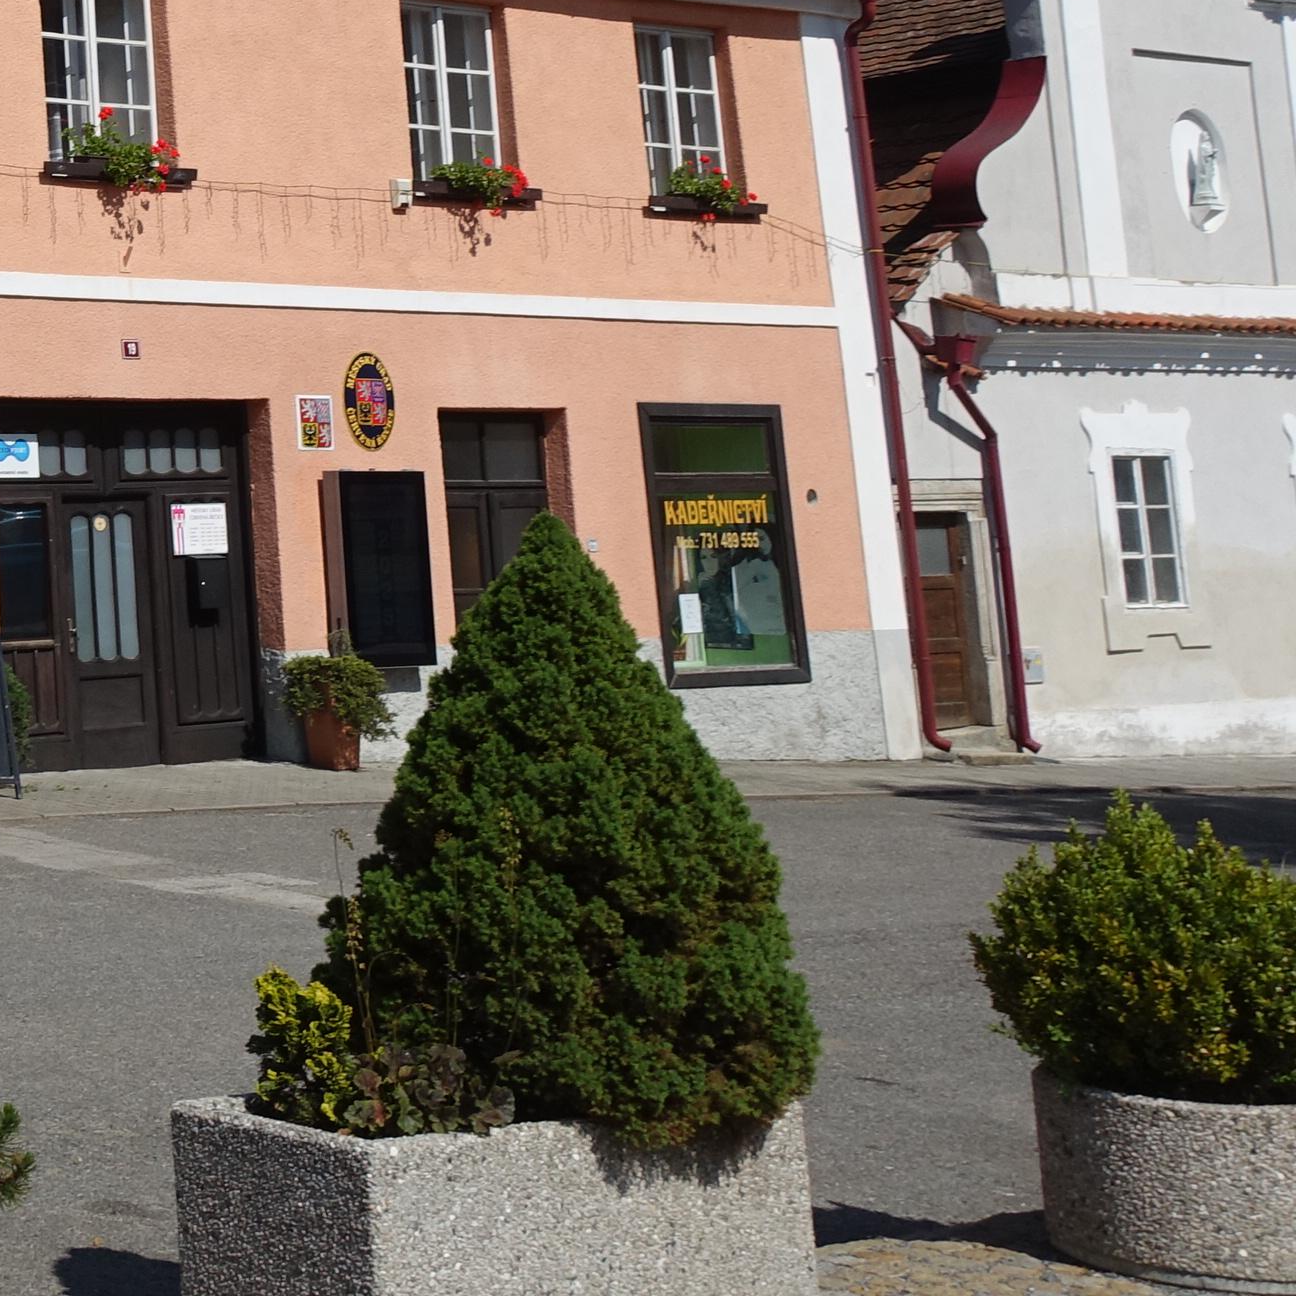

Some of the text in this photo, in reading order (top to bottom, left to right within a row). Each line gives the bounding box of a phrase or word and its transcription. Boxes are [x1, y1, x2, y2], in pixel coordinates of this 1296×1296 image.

[664, 493, 768, 526] KADEŘNICTVÍ
[699, 532, 718, 549] 731
[740, 532, 760, 548] 555
